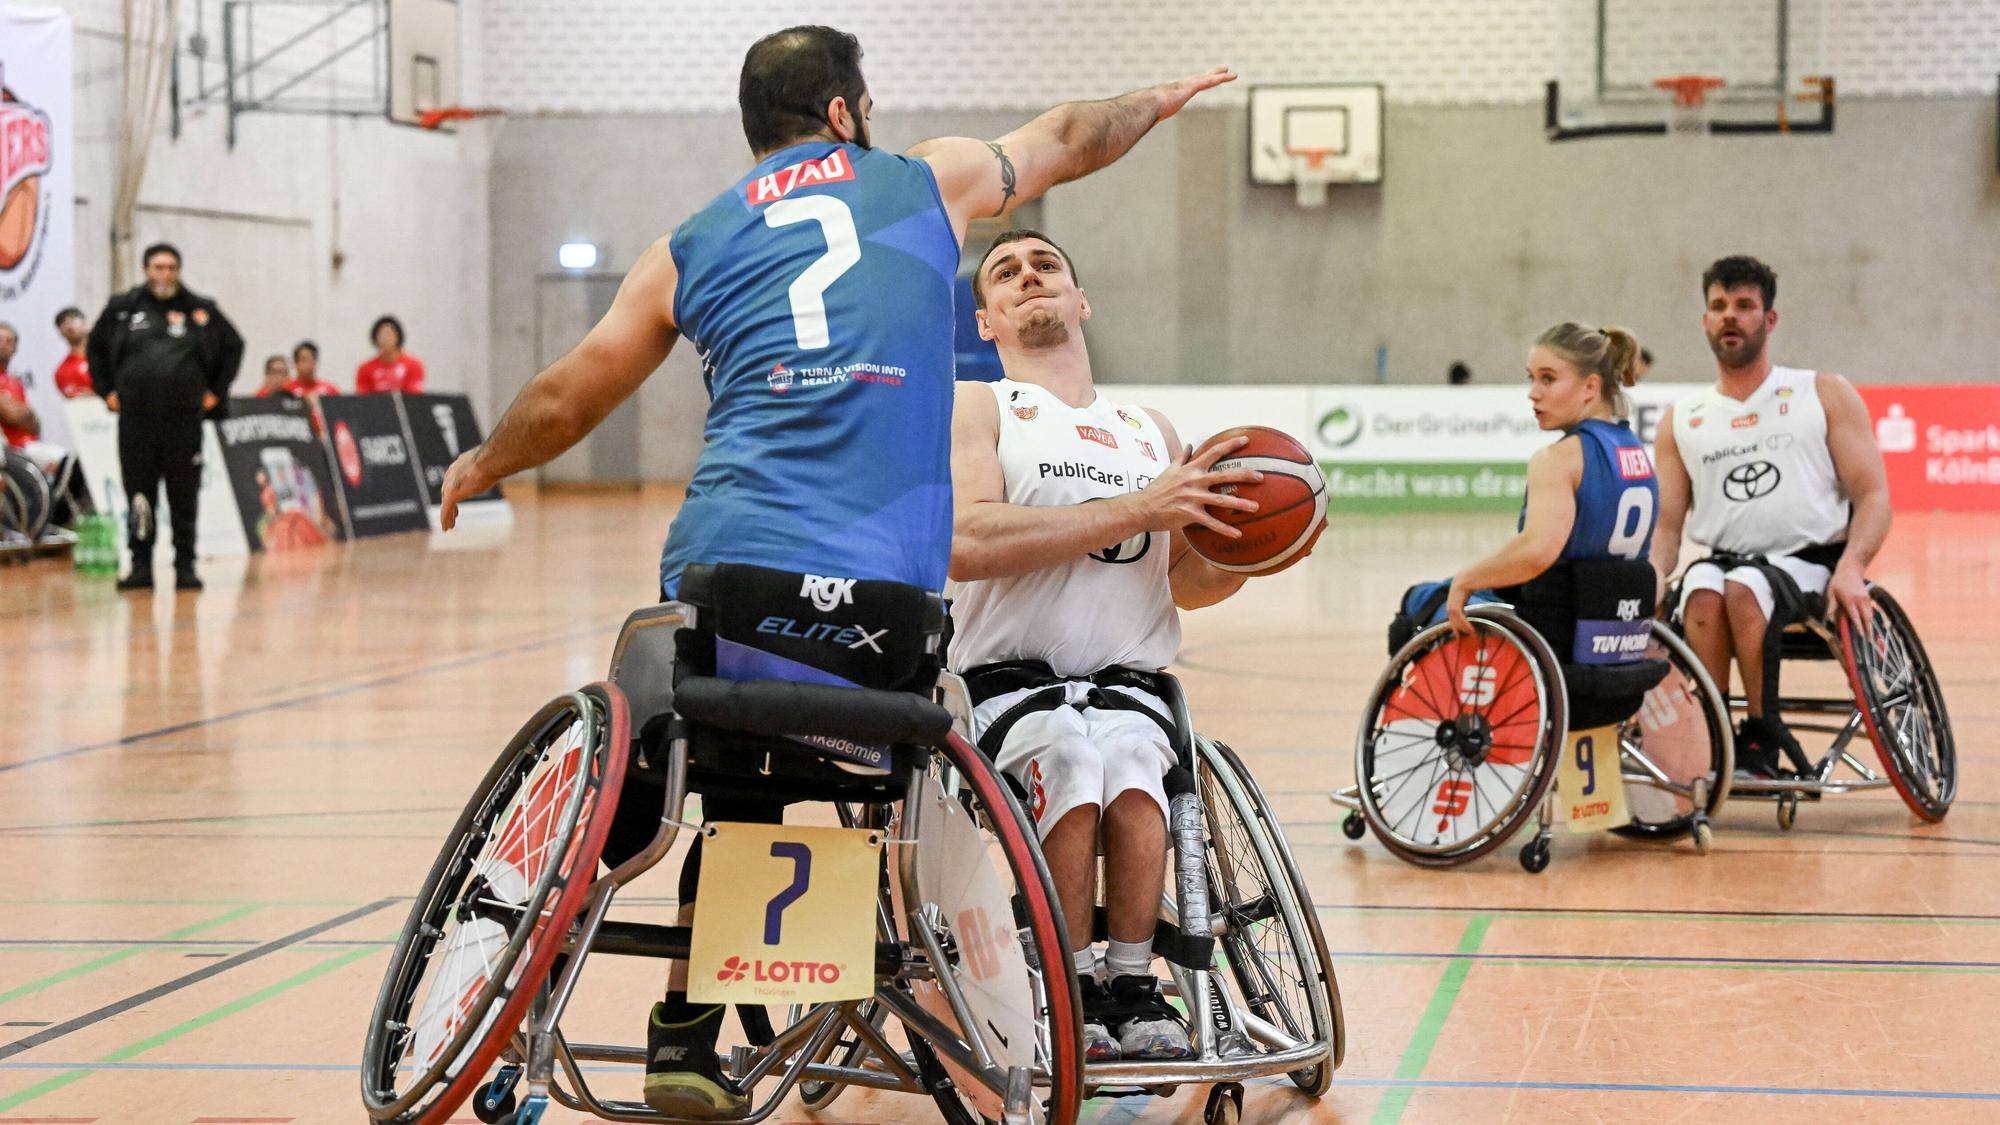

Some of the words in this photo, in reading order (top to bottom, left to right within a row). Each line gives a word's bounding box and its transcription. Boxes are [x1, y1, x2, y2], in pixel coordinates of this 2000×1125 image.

[763, 194, 862, 350] 7
[800, 368, 833, 377] TURN
[834, 366, 842, 376] A
[843, 363, 879, 373] VISION
[881, 364, 906, 377] INTO
[1038, 461, 1124, 487] PubliCare
[800, 574, 858, 612] RGK
[1576, 735, 1595, 796] 9
[763, 841, 812, 945] 7
[754, 960, 840, 984] LOTTO
[654, 1046, 688, 1063] NIKE
